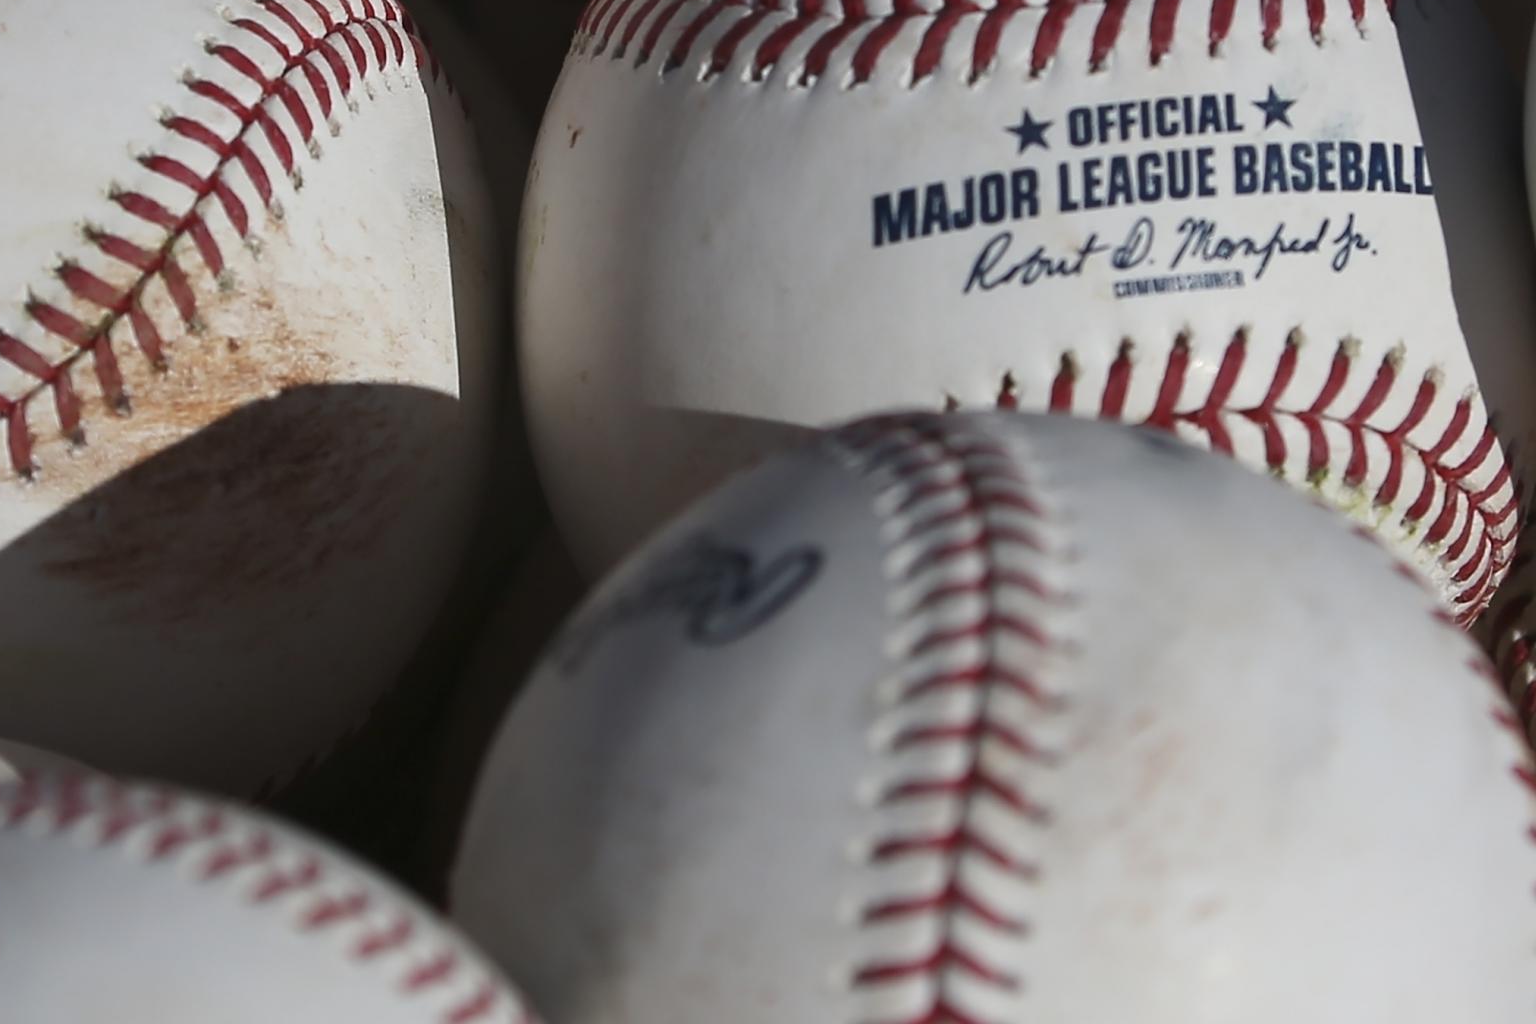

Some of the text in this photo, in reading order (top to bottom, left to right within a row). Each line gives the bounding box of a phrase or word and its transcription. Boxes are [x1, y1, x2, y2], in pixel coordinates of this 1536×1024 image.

[1067, 94, 1244, 147] OFFICIAL
[872, 141, 1434, 247] MAJOR LEAGUE BASEBALL
